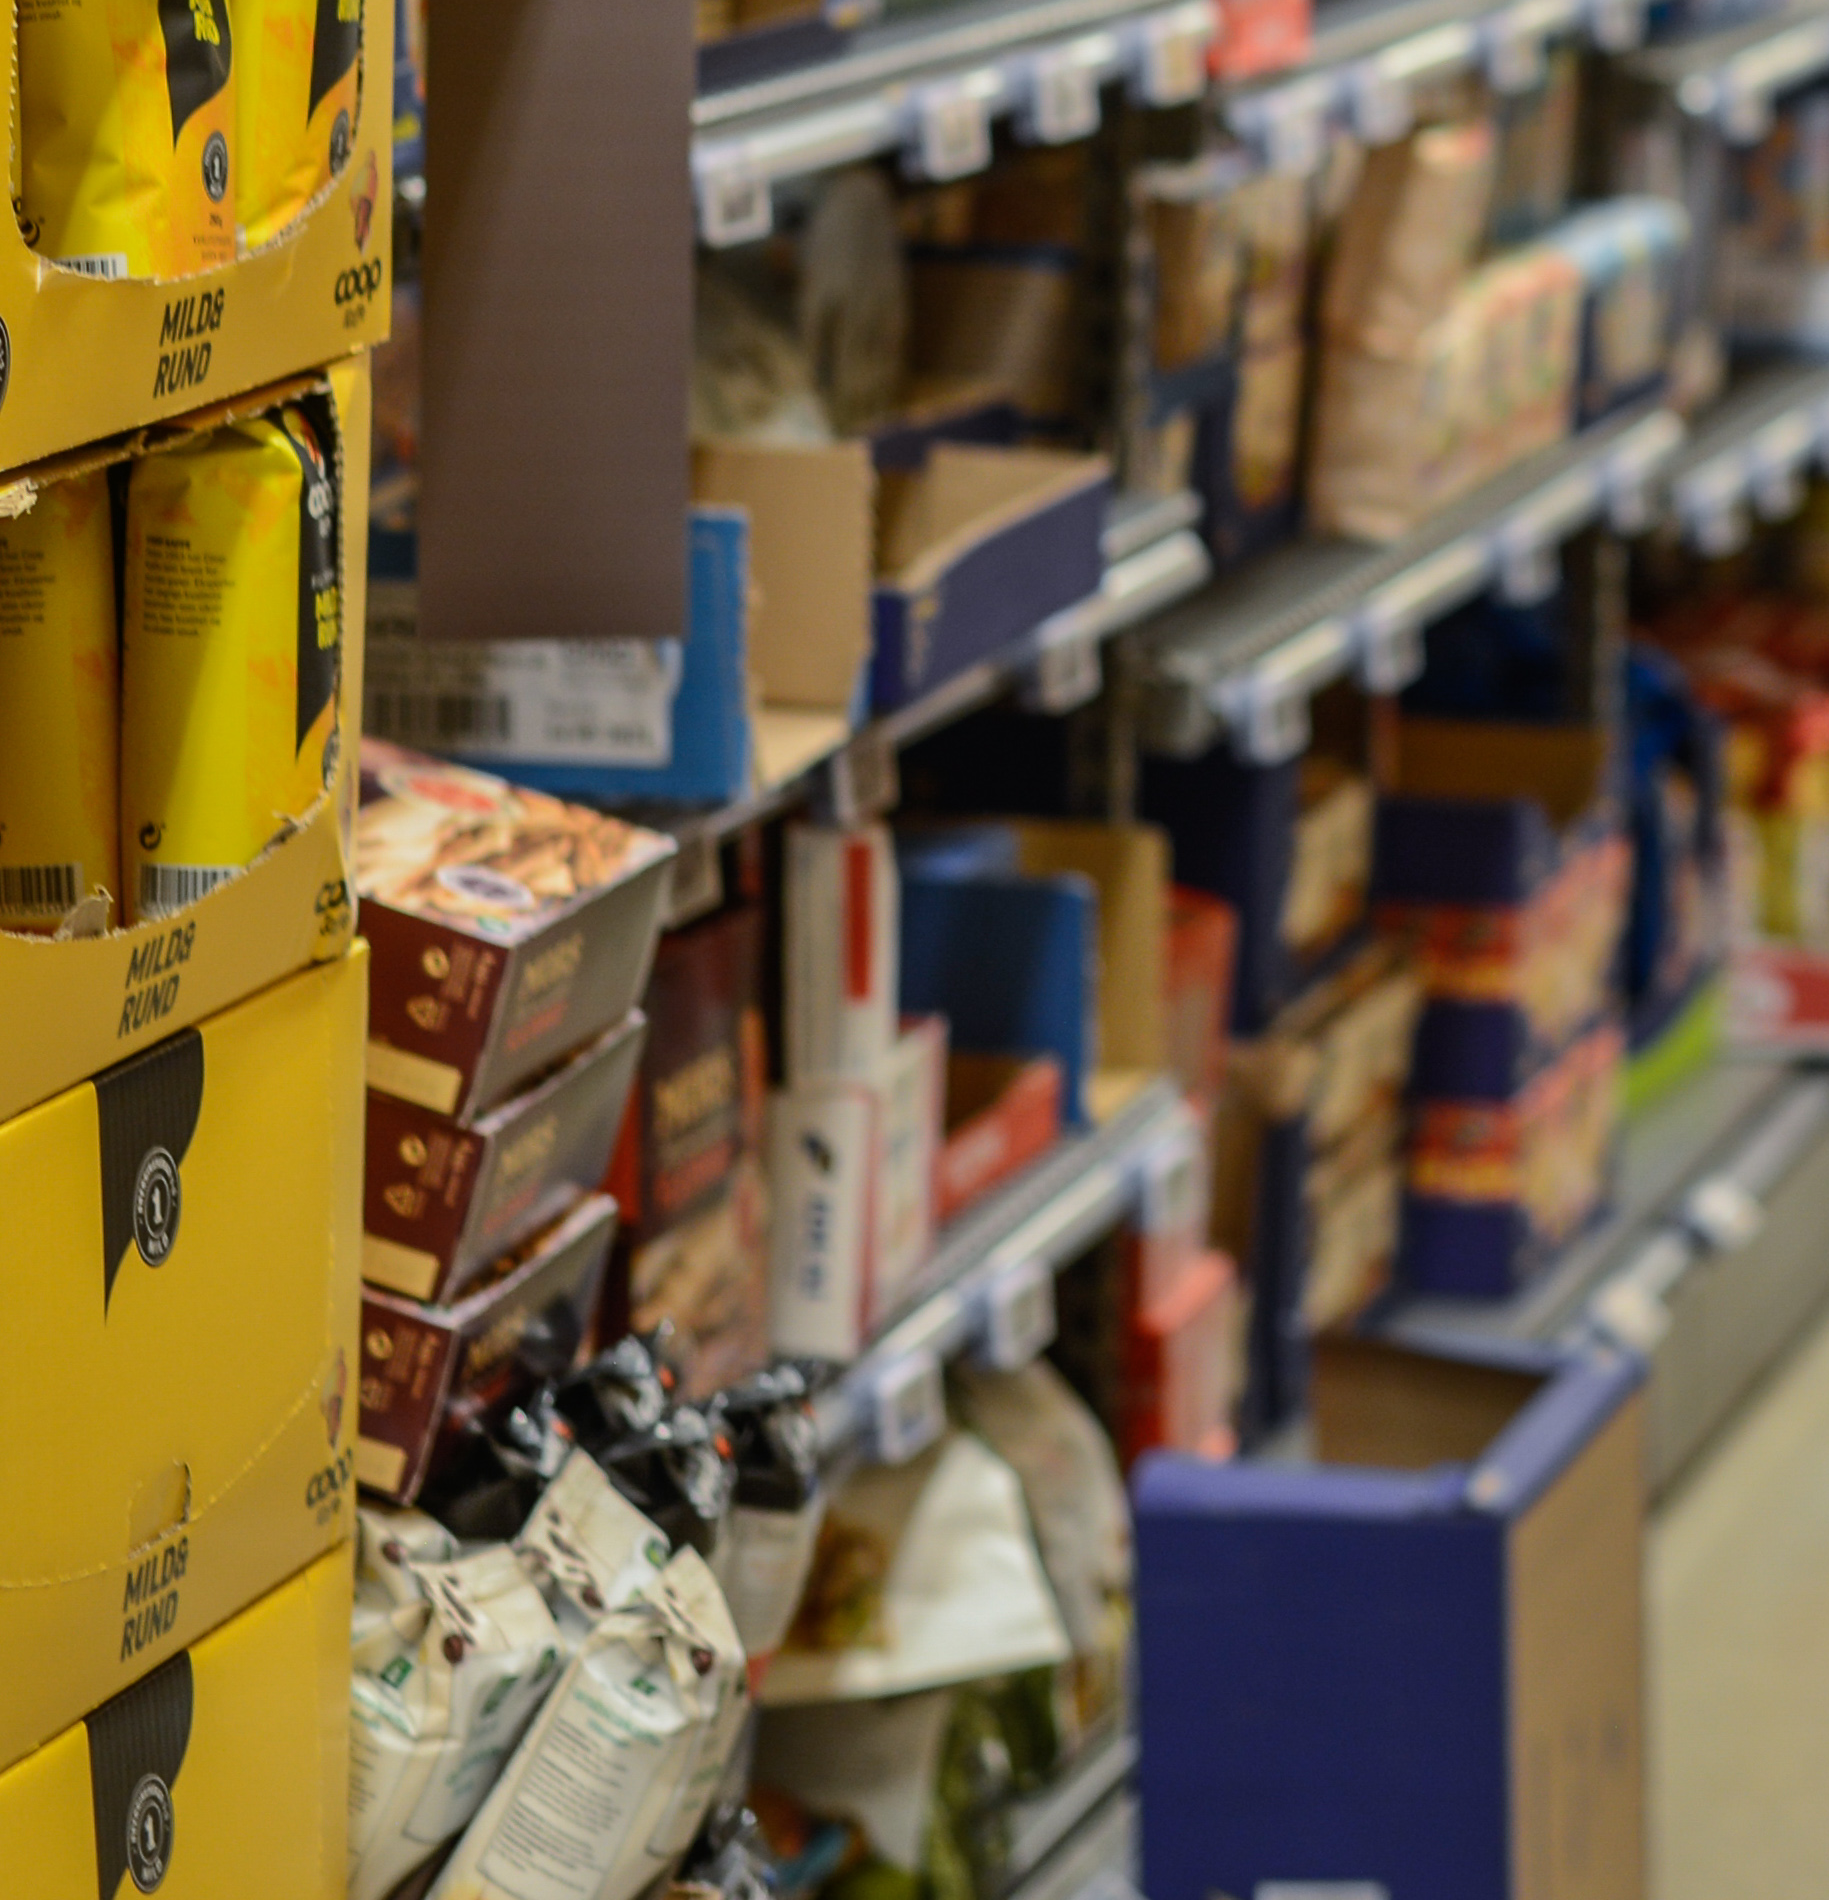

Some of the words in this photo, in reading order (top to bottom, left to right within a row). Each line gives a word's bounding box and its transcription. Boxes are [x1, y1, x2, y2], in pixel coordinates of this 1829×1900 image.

[334, 257, 382, 306] coop
[159, 287, 225, 348] MILD&
[153, 341, 212, 400] RUND
[125, 920, 197, 990] MILD&
[117, 973, 180, 1040] RUND
[152, 1183, 165, 1225] 1
[123, 1536, 190, 1614] MILD&
[120, 1588, 180, 1664] RUND
[143, 1811, 156, 1852] 1
